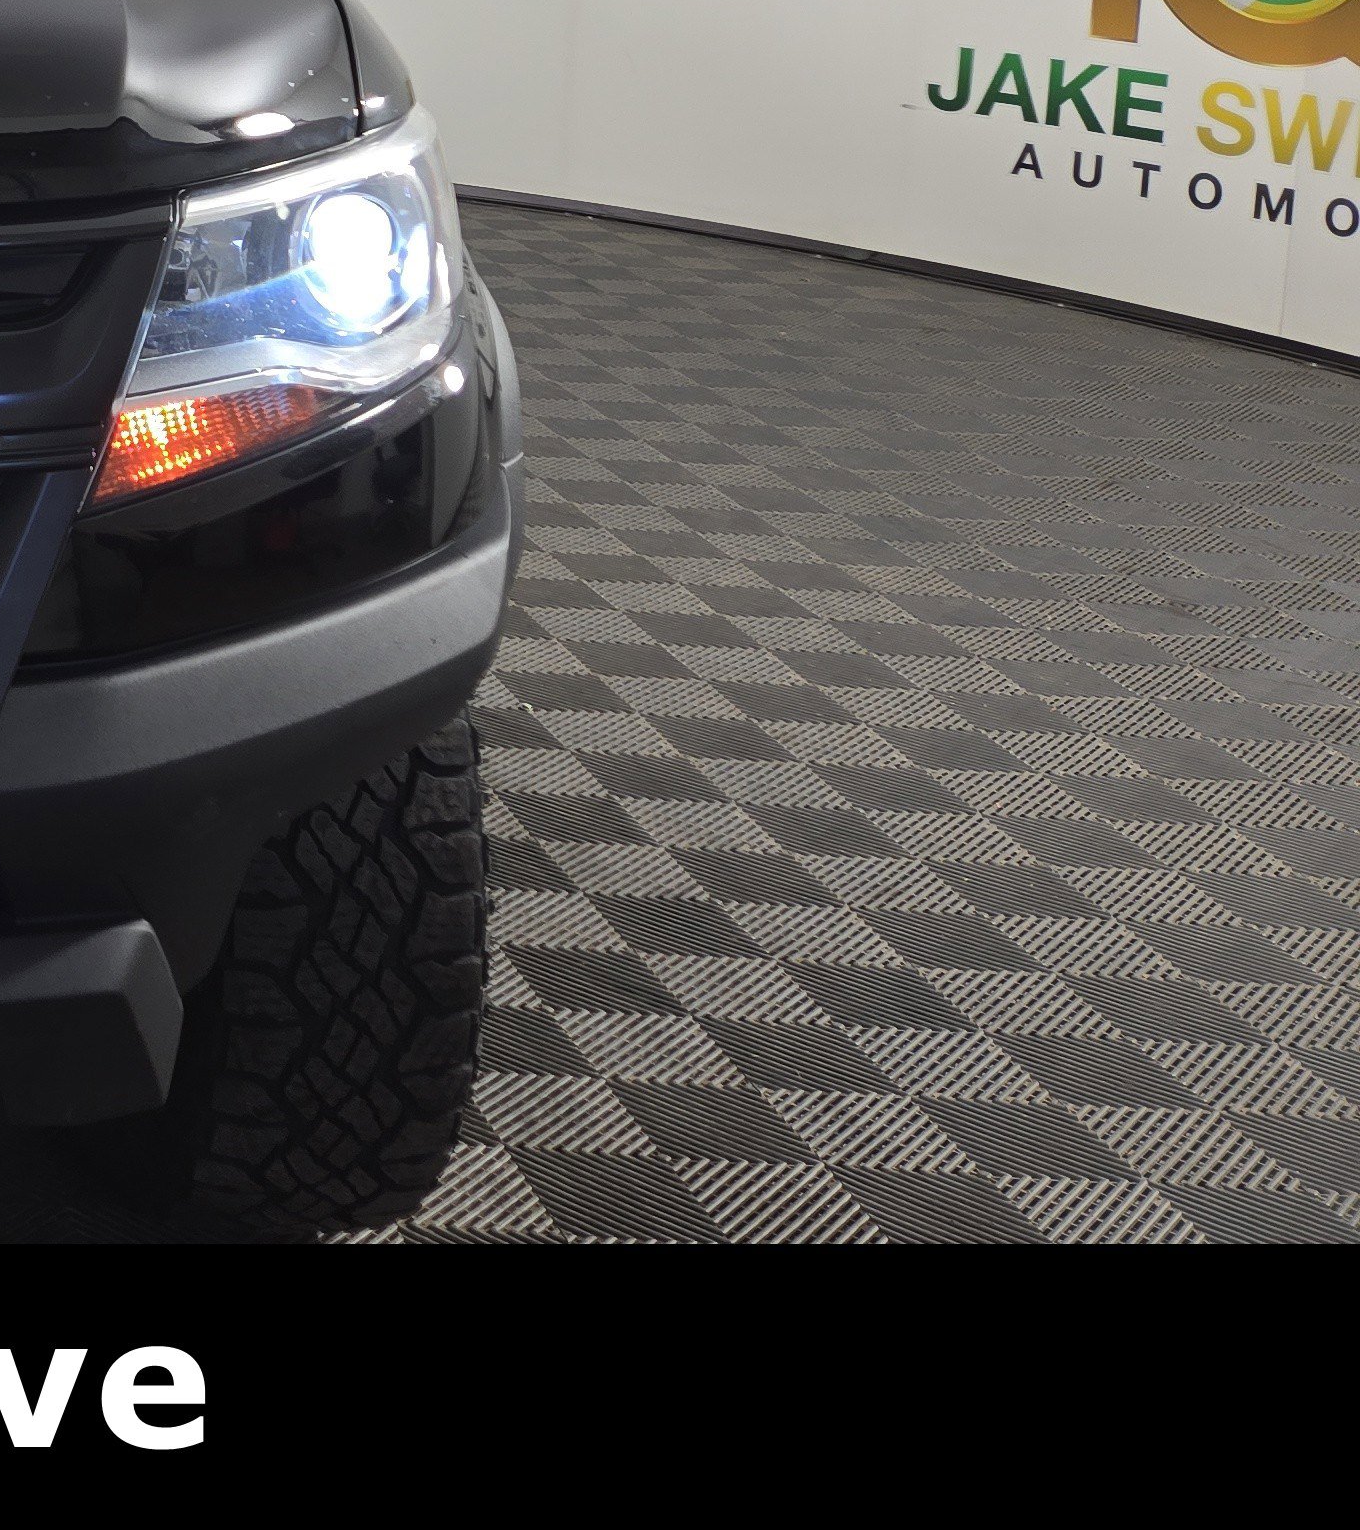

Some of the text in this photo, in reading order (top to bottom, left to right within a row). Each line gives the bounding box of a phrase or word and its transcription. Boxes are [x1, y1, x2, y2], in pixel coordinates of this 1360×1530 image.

[926, 46, 1360, 179] JAKE SW
[1011, 142, 1360, 238] AUTOMO
